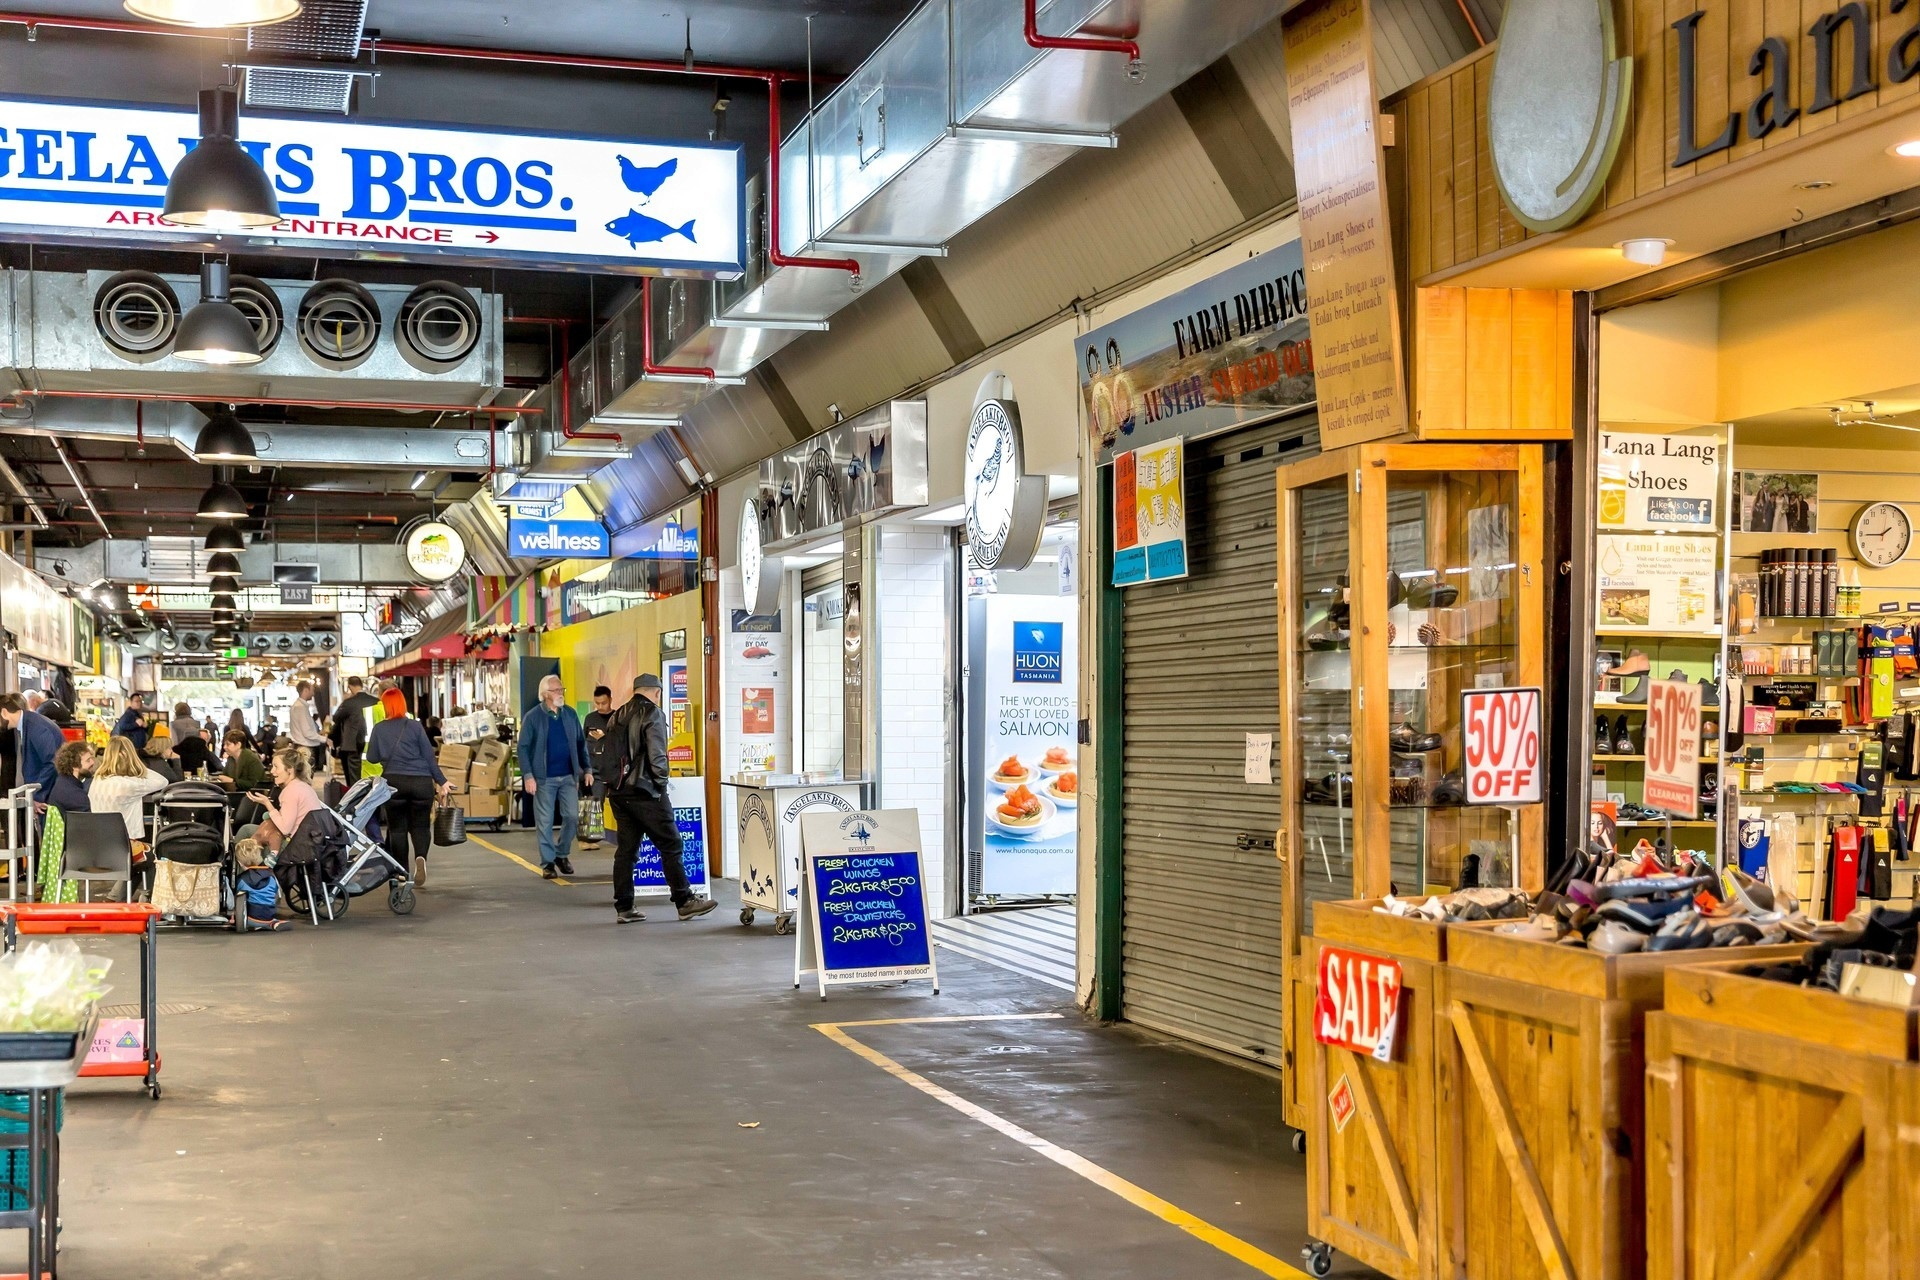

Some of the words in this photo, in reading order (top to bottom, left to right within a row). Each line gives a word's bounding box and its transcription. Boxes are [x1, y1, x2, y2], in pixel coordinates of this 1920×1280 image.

[341, 147, 574, 221] BROS.
[1301, 203, 1321, 221] Expert
[271, 218, 453, 243] ENTRANCE
[1308, 238, 1325, 253] Lana
[1326, 231, 1344, 246] Lang
[1345, 221, 1365, 238] Shoes
[1369, 274, 1386, 291] agus
[1173, 300, 1232, 361] FARM
[1233, 266, 1309, 337] DIREC
[1602, 434, 1656, 456] Lana
[1662, 437, 1715, 465] Lang
[1627, 470, 1688, 490] Shoes
[1651, 500, 1668, 510] Like
[1682, 502, 1695, 510] On
[1650, 509, 1695, 522] facebook
[518, 524, 601, 551] wellness
[284, 589, 308, 600] EAST
[1015, 654, 1060, 668] HUON
[1000, 696, 1019, 706] THE
[1022, 696, 1070, 708] WORLD'S
[1000, 709, 1031, 719] MOST
[1034, 709, 1070, 720] LOVED
[1466, 691, 1537, 769] 50%
[1649, 685, 1697, 775] 50%
[1680, 738, 1694, 752] OFF
[1472, 769, 1532, 797] OFF
[1648, 786, 1691, 803] CLEARANCE
[786, 792, 832, 819] ANGELAKIS
[673, 808, 702, 821] FREE
[817, 857, 849, 869] FRESH
[851, 856, 895, 868] CHICKEN
[632, 867, 665, 881] Flathea
[843, 868, 881, 880] WINGS
[861, 881, 882, 892] FOR
[823, 900, 854, 913] FRESH
[855, 899, 896, 911] CHICKEN
[843, 910, 906, 923] DRUMSTICKS
[861, 927, 880, 938] FOR
[839, 971, 855, 979] most
[855, 969, 878, 978] trusted
[878, 969, 896, 977] name
[896, 967, 903, 976] in
[1321, 953, 1395, 1049] SALE
